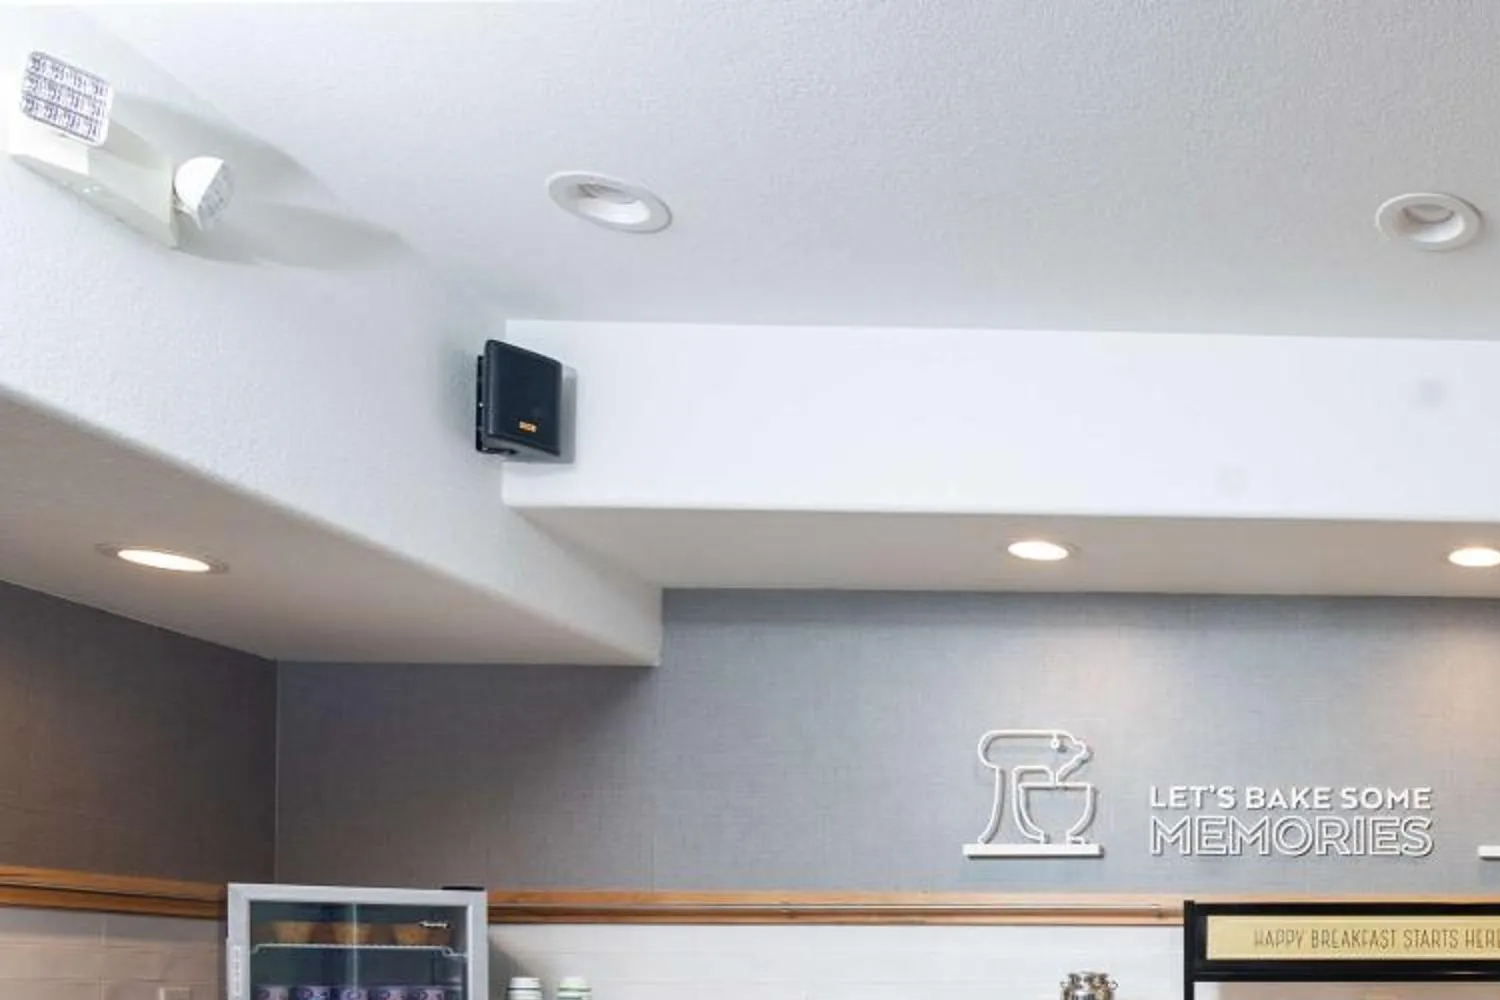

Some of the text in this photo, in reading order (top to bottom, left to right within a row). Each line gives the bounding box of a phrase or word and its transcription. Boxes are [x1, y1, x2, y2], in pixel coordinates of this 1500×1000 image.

[1150, 785, 1432, 811] LET'S BAKE SOME
[1150, 815, 1434, 857] MEMORIES
[1254, 928, 1305, 949] HAPPY
[1310, 928, 1397, 949] BREAKFAST
[1402, 928, 1458, 949] STARTS
